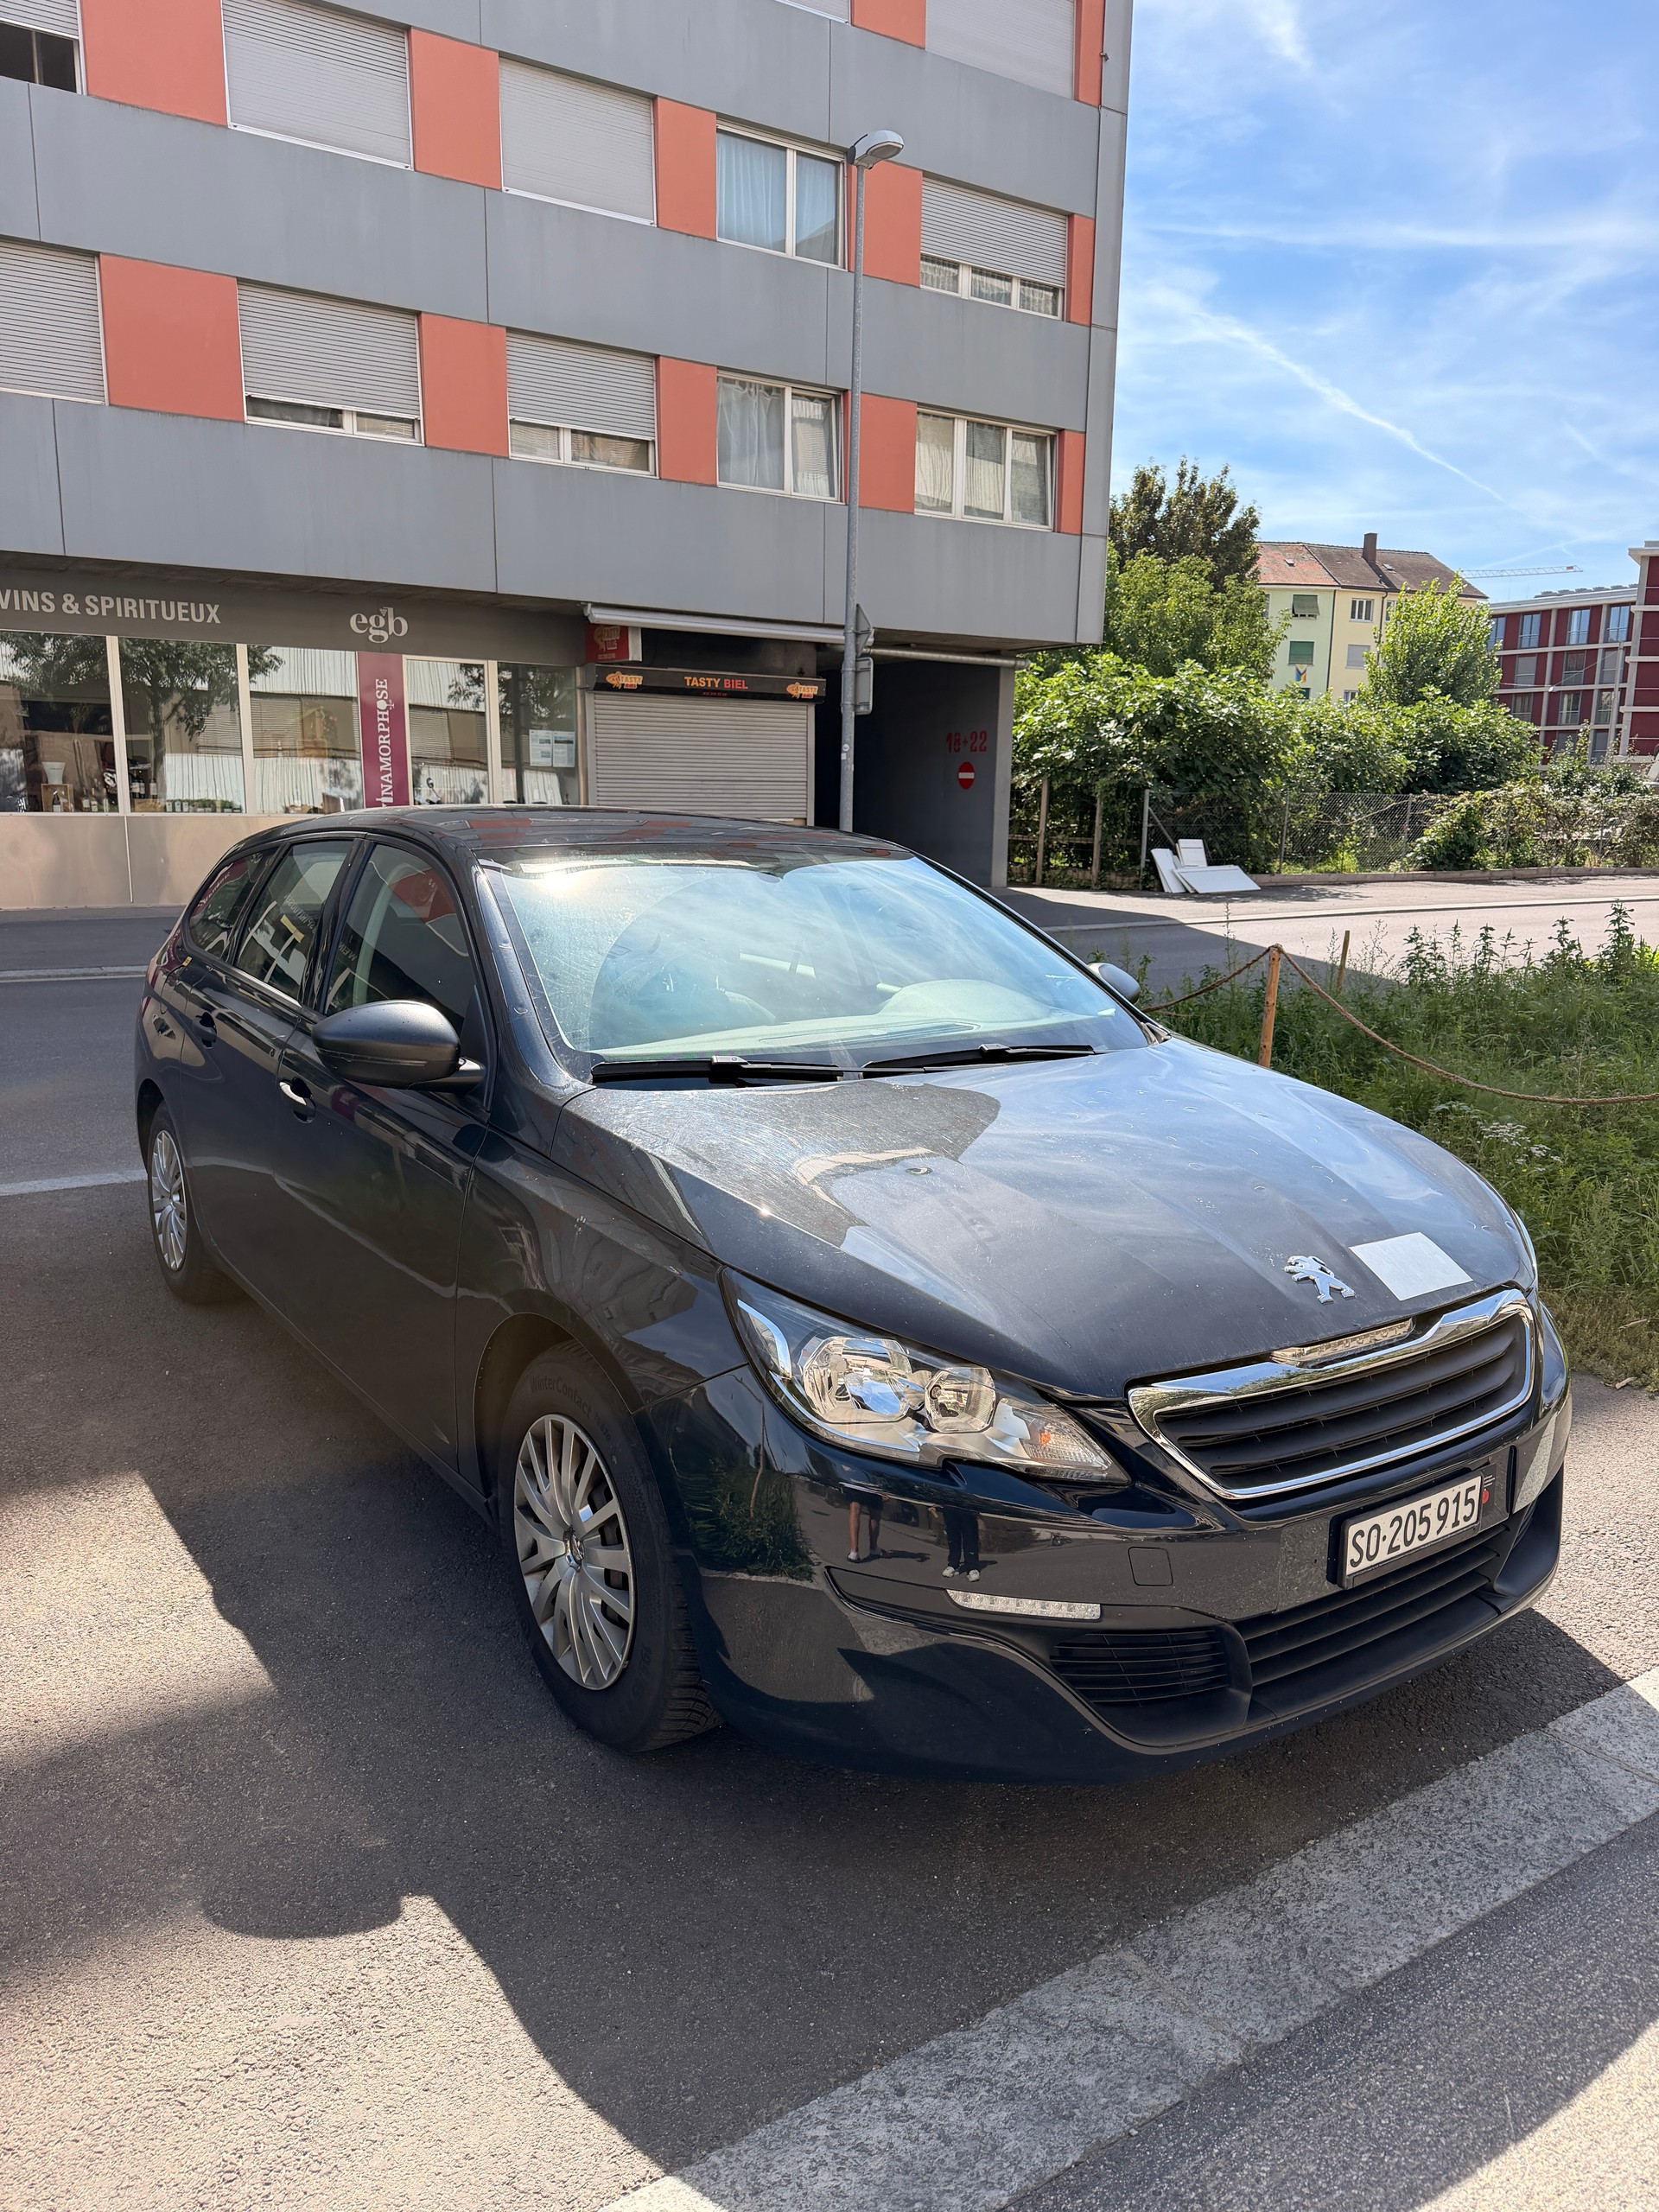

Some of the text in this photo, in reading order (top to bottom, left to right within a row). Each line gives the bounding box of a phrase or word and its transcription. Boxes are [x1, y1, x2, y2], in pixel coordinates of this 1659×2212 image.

[0, 589, 221, 624] VINS & SPIRITUEUX
[349, 607, 409, 644] egb
[684, 677, 748, 690] TASTY BIEL
[375, 678, 395, 807] INAMORPHOSE
[530, 1375, 593, 1420] WinterContact
